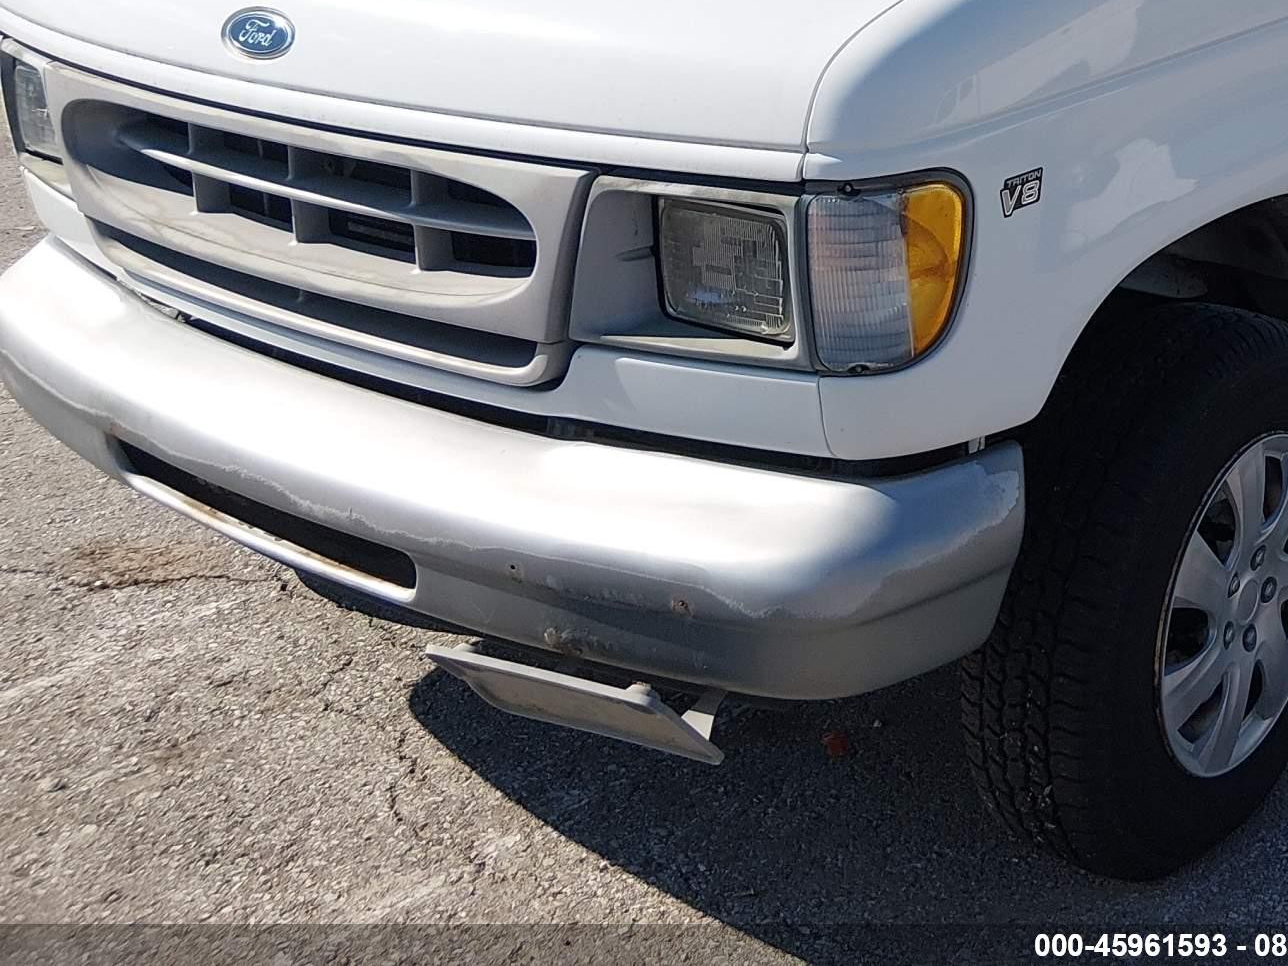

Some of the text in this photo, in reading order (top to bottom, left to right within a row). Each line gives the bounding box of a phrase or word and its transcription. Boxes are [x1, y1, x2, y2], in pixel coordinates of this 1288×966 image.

[239, 19, 277, 47] Ford
[1006, 169, 1042, 188] TRITON
[1001, 180, 1040, 216] V8
